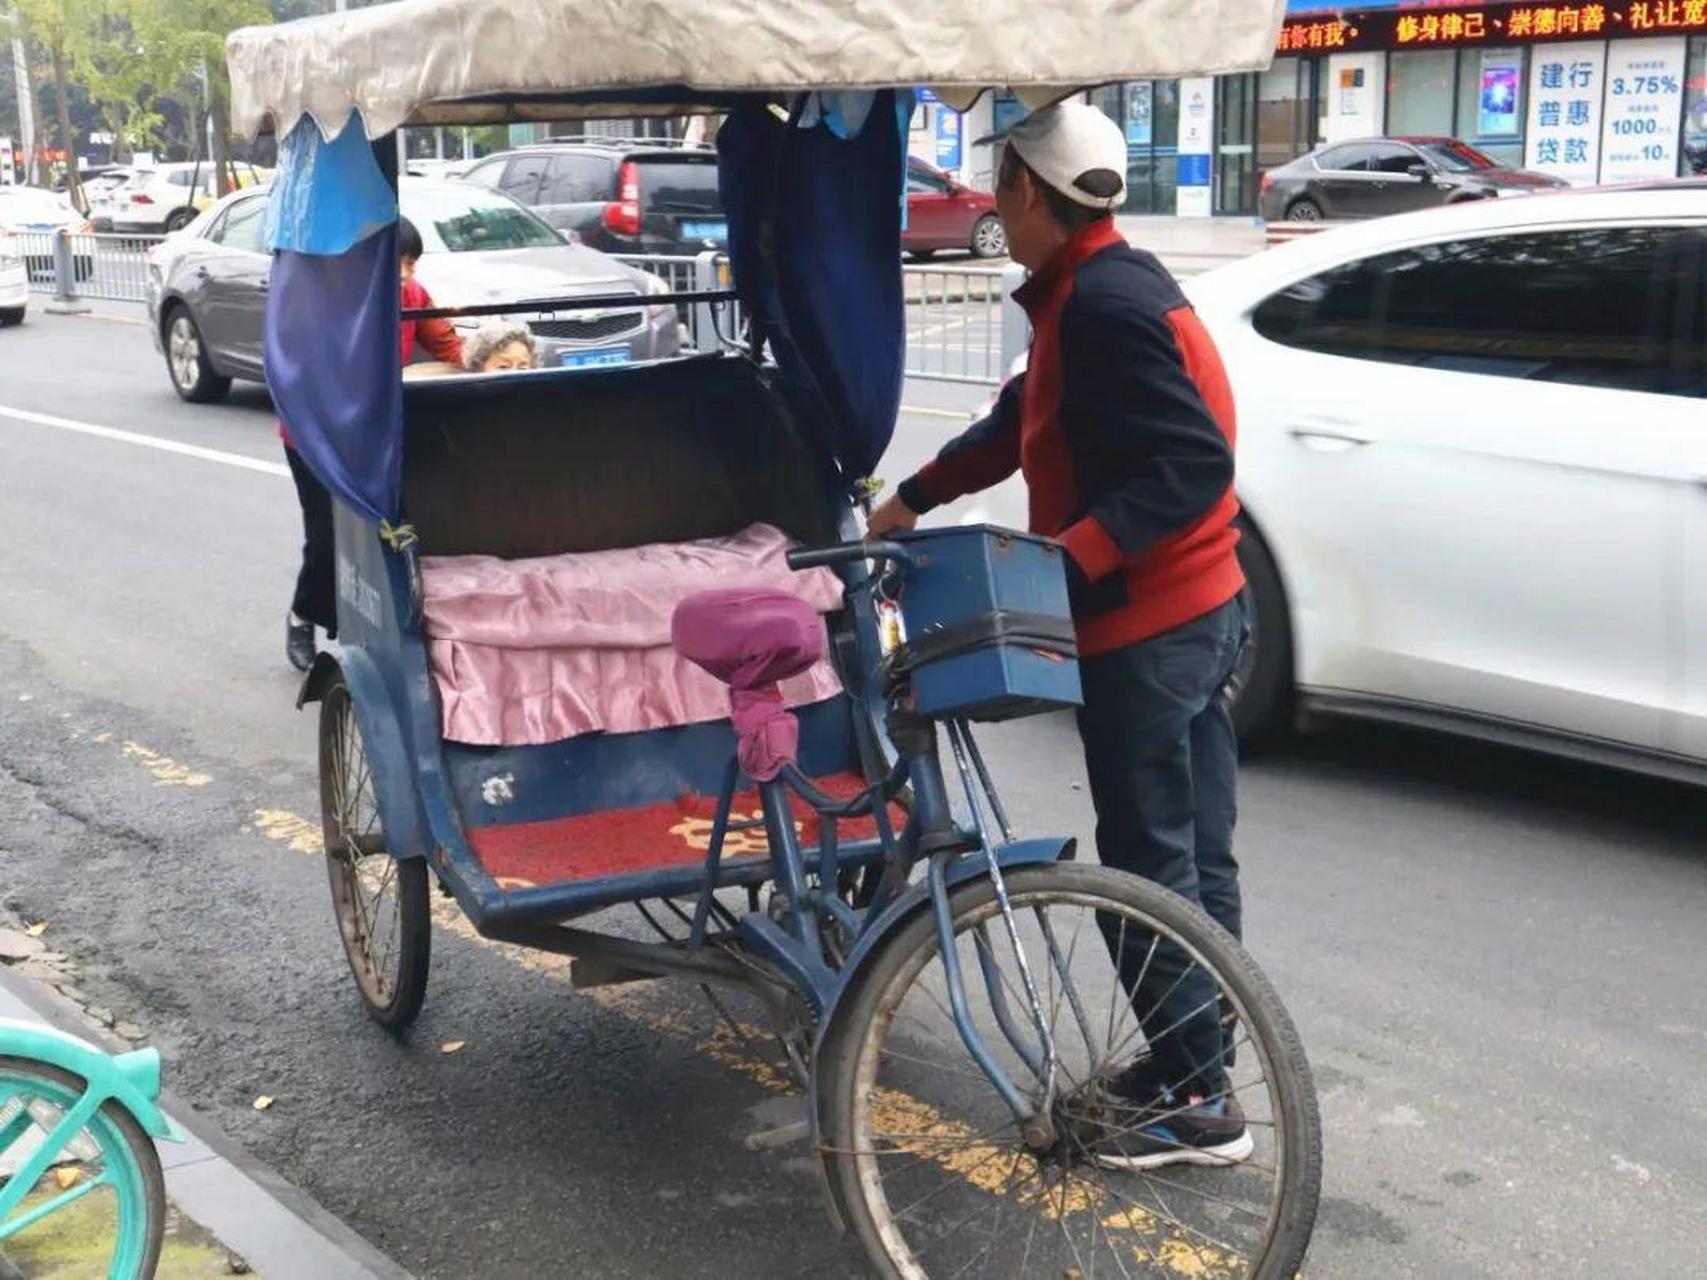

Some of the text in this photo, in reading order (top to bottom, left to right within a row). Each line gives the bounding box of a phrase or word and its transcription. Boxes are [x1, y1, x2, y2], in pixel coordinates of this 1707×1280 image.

[1541, 62, 1593, 88] 建行
[1612, 75, 1679, 95] 3.75%
[1539, 100, 1590, 126] 普惠
[1612, 118, 1657, 135] 1000
[1536, 138, 1588, 164] 贷款
